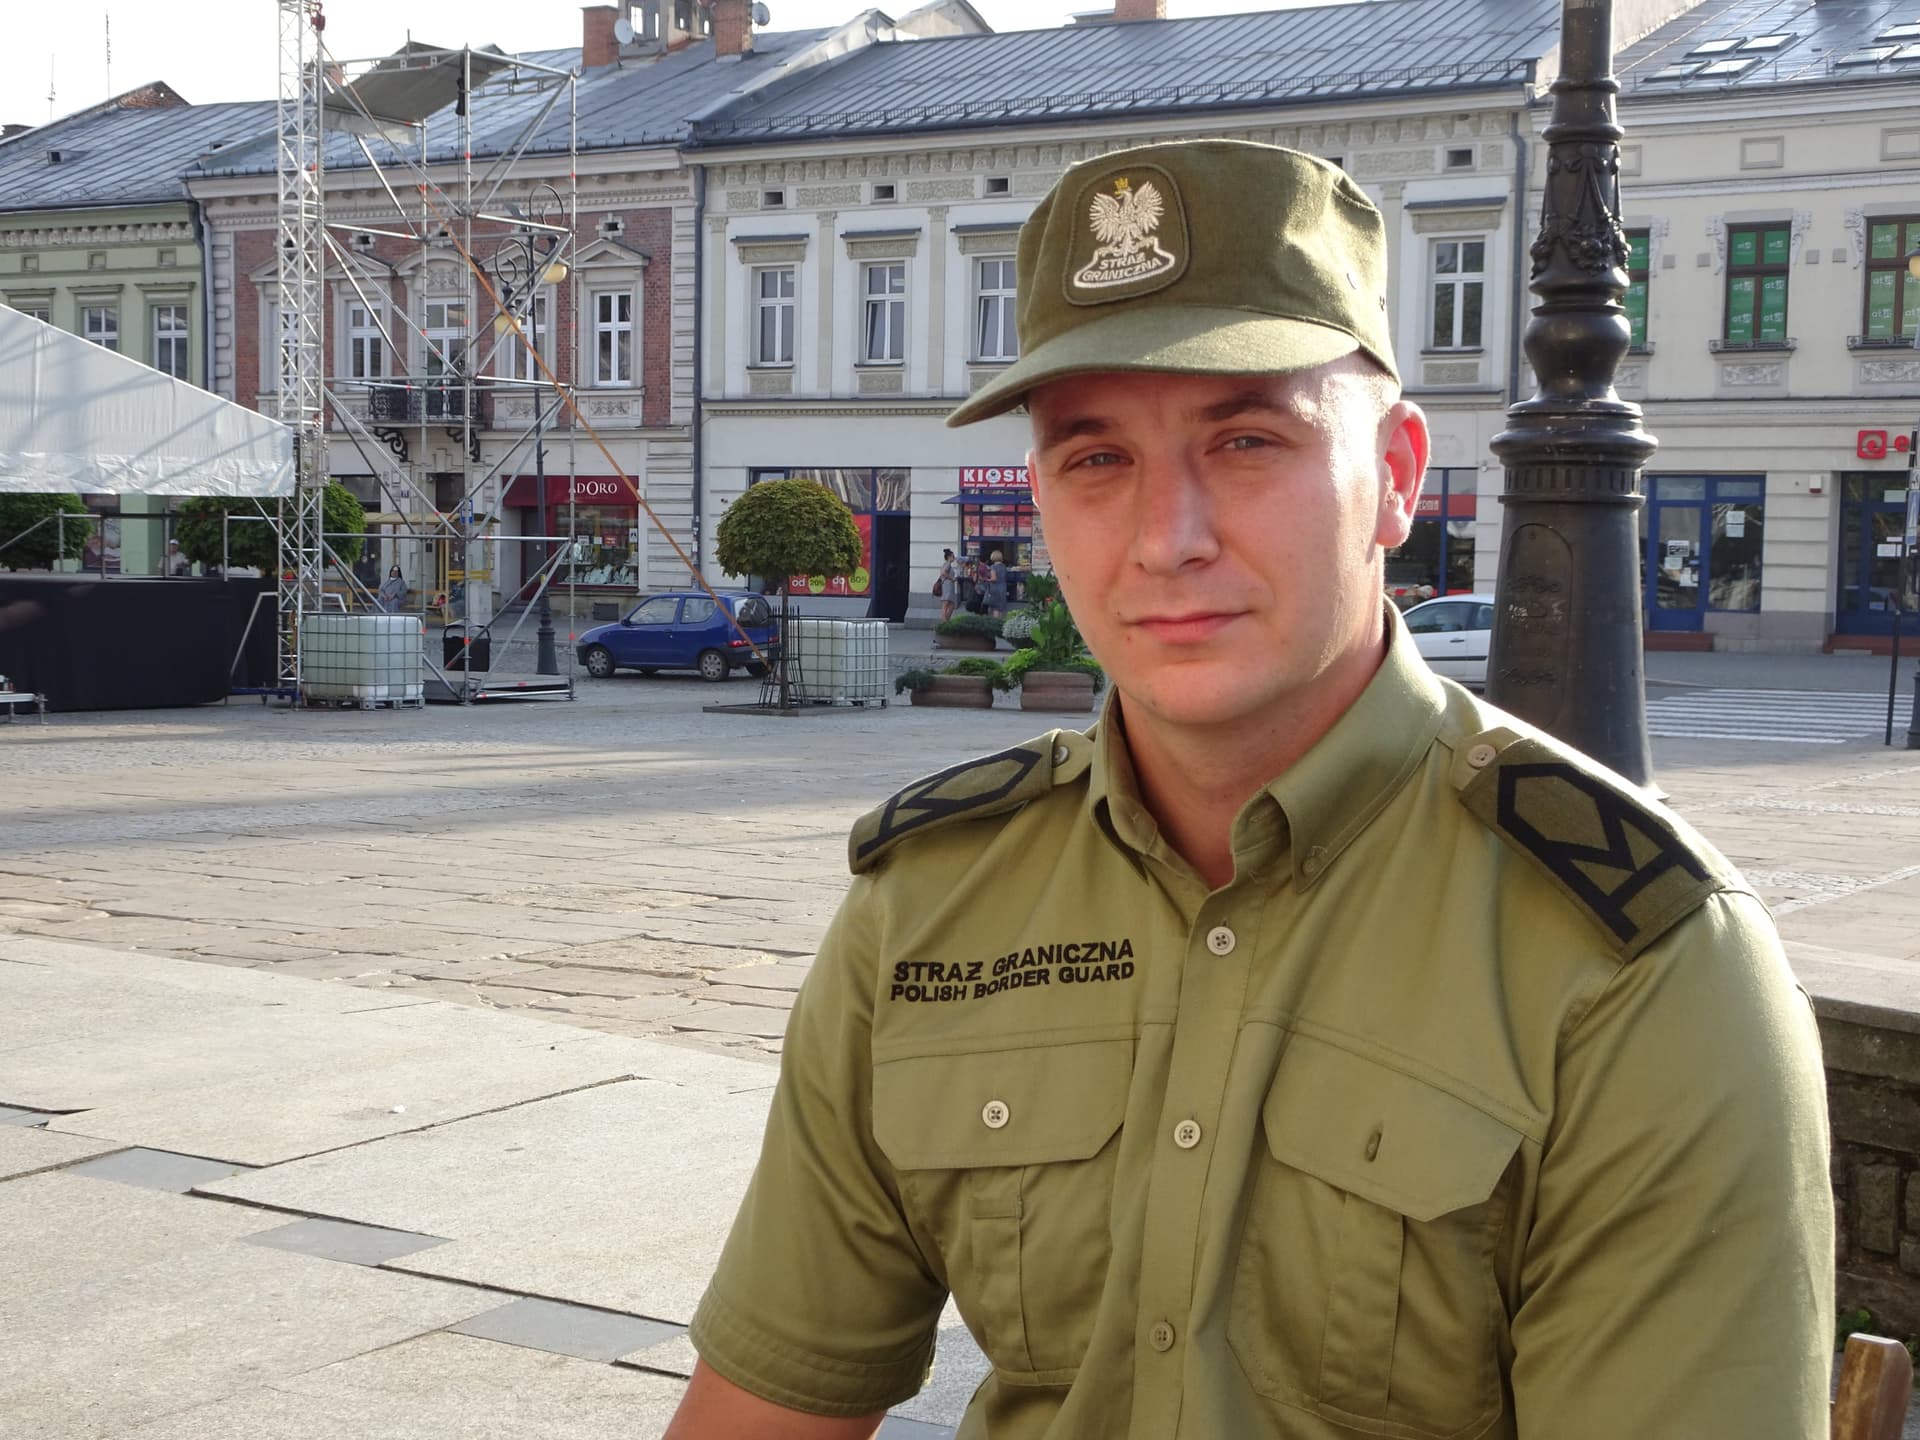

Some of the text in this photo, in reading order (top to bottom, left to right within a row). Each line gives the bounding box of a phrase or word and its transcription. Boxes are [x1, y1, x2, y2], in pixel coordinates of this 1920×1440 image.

[1082, 257, 1162, 281] GRANICZNA
[963, 468, 1029, 483] KIOSK
[992, 938, 1134, 977] GRANICZNA
[891, 961, 1135, 1002] POLISH BORDER GUARD
